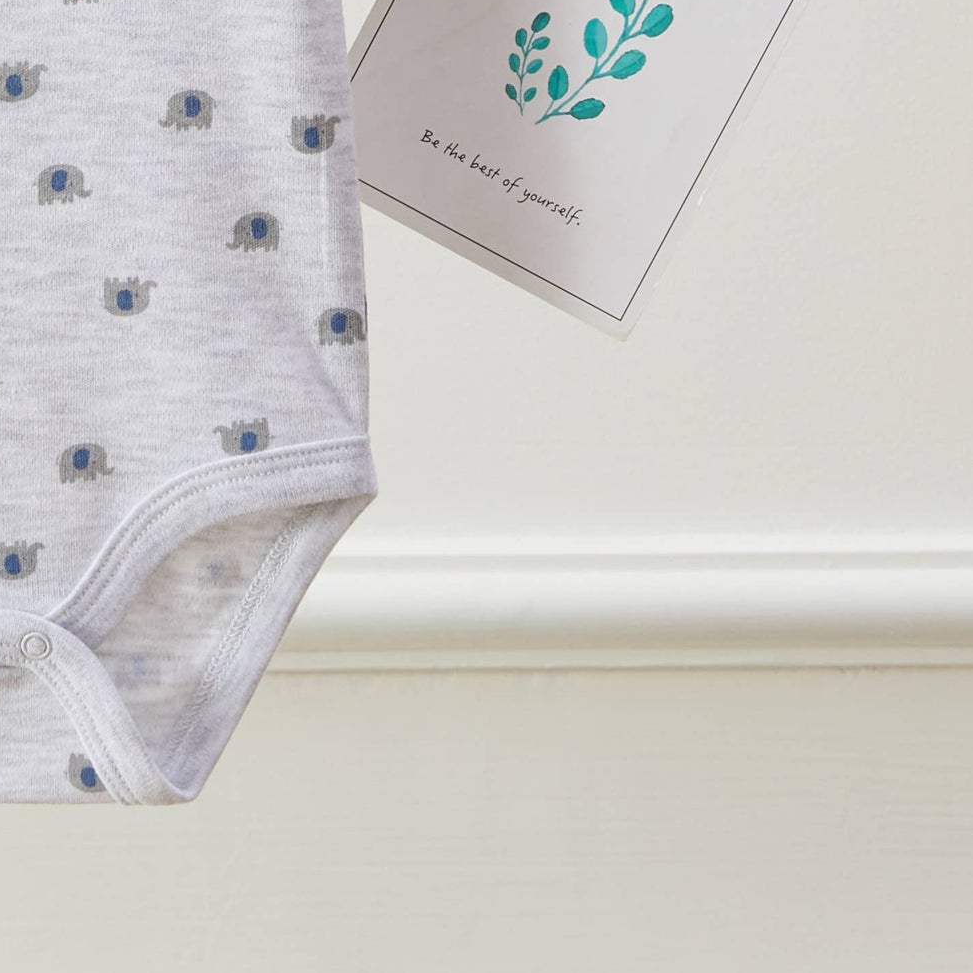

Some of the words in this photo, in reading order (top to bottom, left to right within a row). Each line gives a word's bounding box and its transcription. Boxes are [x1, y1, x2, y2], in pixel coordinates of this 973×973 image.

[420, 129, 440, 148] Be
[443, 143, 467, 163] the
[470, 154, 501, 179] best
[502, 177, 524, 193] of
[517, 188, 583, 225] yourself.
